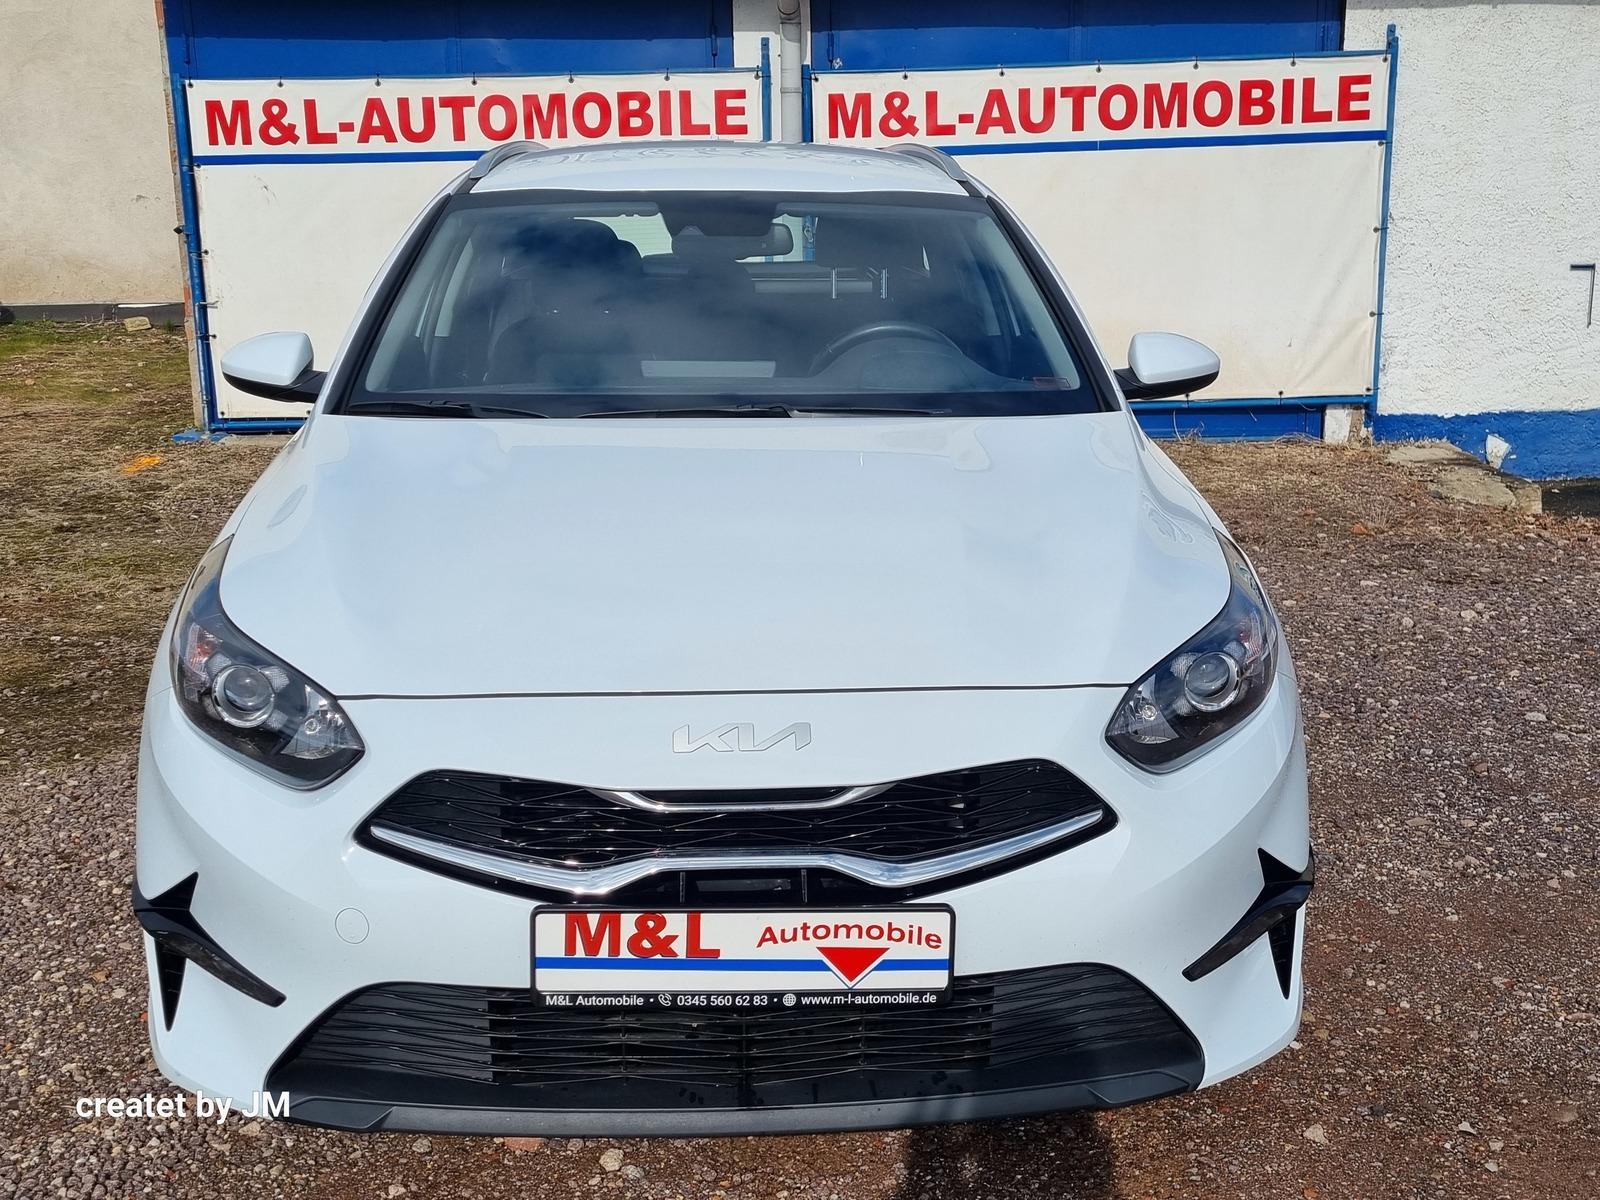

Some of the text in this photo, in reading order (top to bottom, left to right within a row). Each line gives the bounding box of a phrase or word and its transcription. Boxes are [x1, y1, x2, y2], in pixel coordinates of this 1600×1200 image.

[204, 88, 748, 147] M&L-AUTOMOBILE
[826, 73, 1373, 139] M&L-AUTOMOBILE
[672, 722, 812, 754] KIA
[564, 911, 943, 959] M&L Automobile
[545, 992, 937, 1007] M&L Automobile 0345 560 62 83 www.m-l-automobile.de
